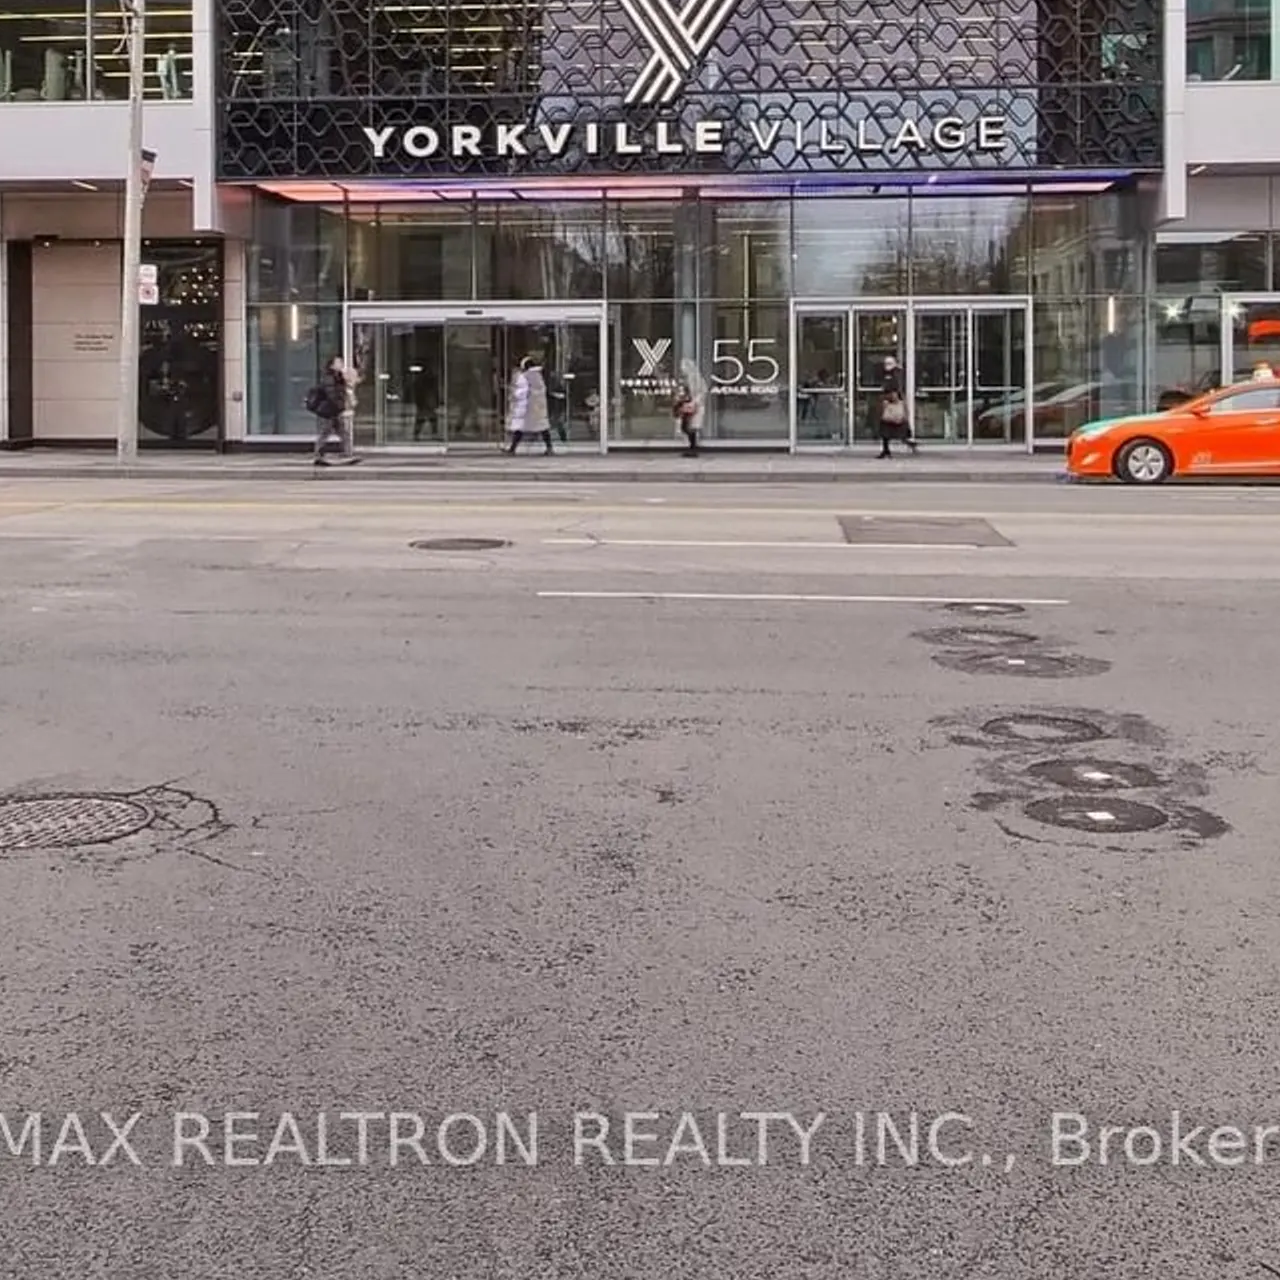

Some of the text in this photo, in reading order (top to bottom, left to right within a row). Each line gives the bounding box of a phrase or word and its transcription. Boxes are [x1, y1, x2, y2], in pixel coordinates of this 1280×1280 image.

[363, 115, 1008, 158] YORKVILLE VILLAGE
[710, 338, 780, 385] 55
